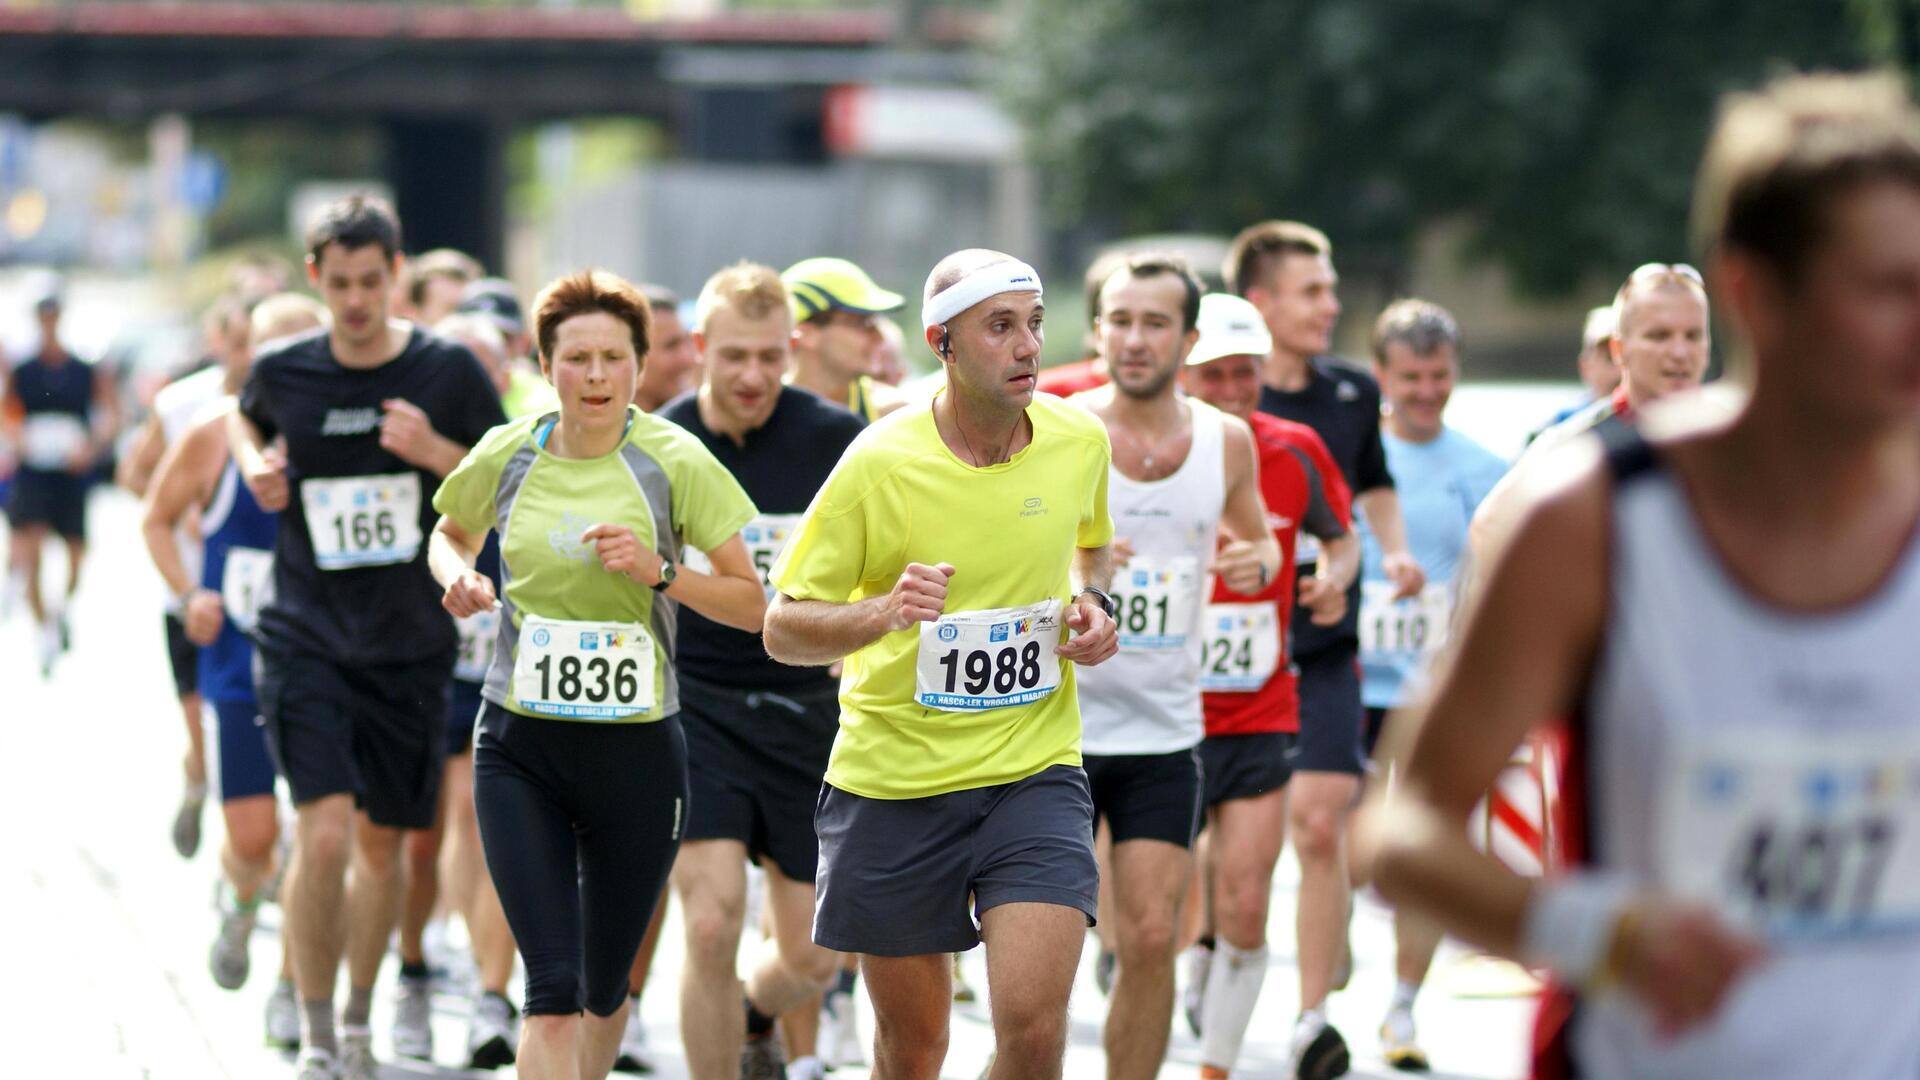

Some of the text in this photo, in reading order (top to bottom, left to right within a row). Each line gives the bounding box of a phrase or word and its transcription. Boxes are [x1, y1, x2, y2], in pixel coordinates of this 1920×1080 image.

[332, 511, 397, 553] 166
[1374, 614, 1429, 651] 110
[535, 654, 638, 704] 1836
[939, 640, 1041, 695] 1988
[937, 696, 982, 707] HASCO-LEK
